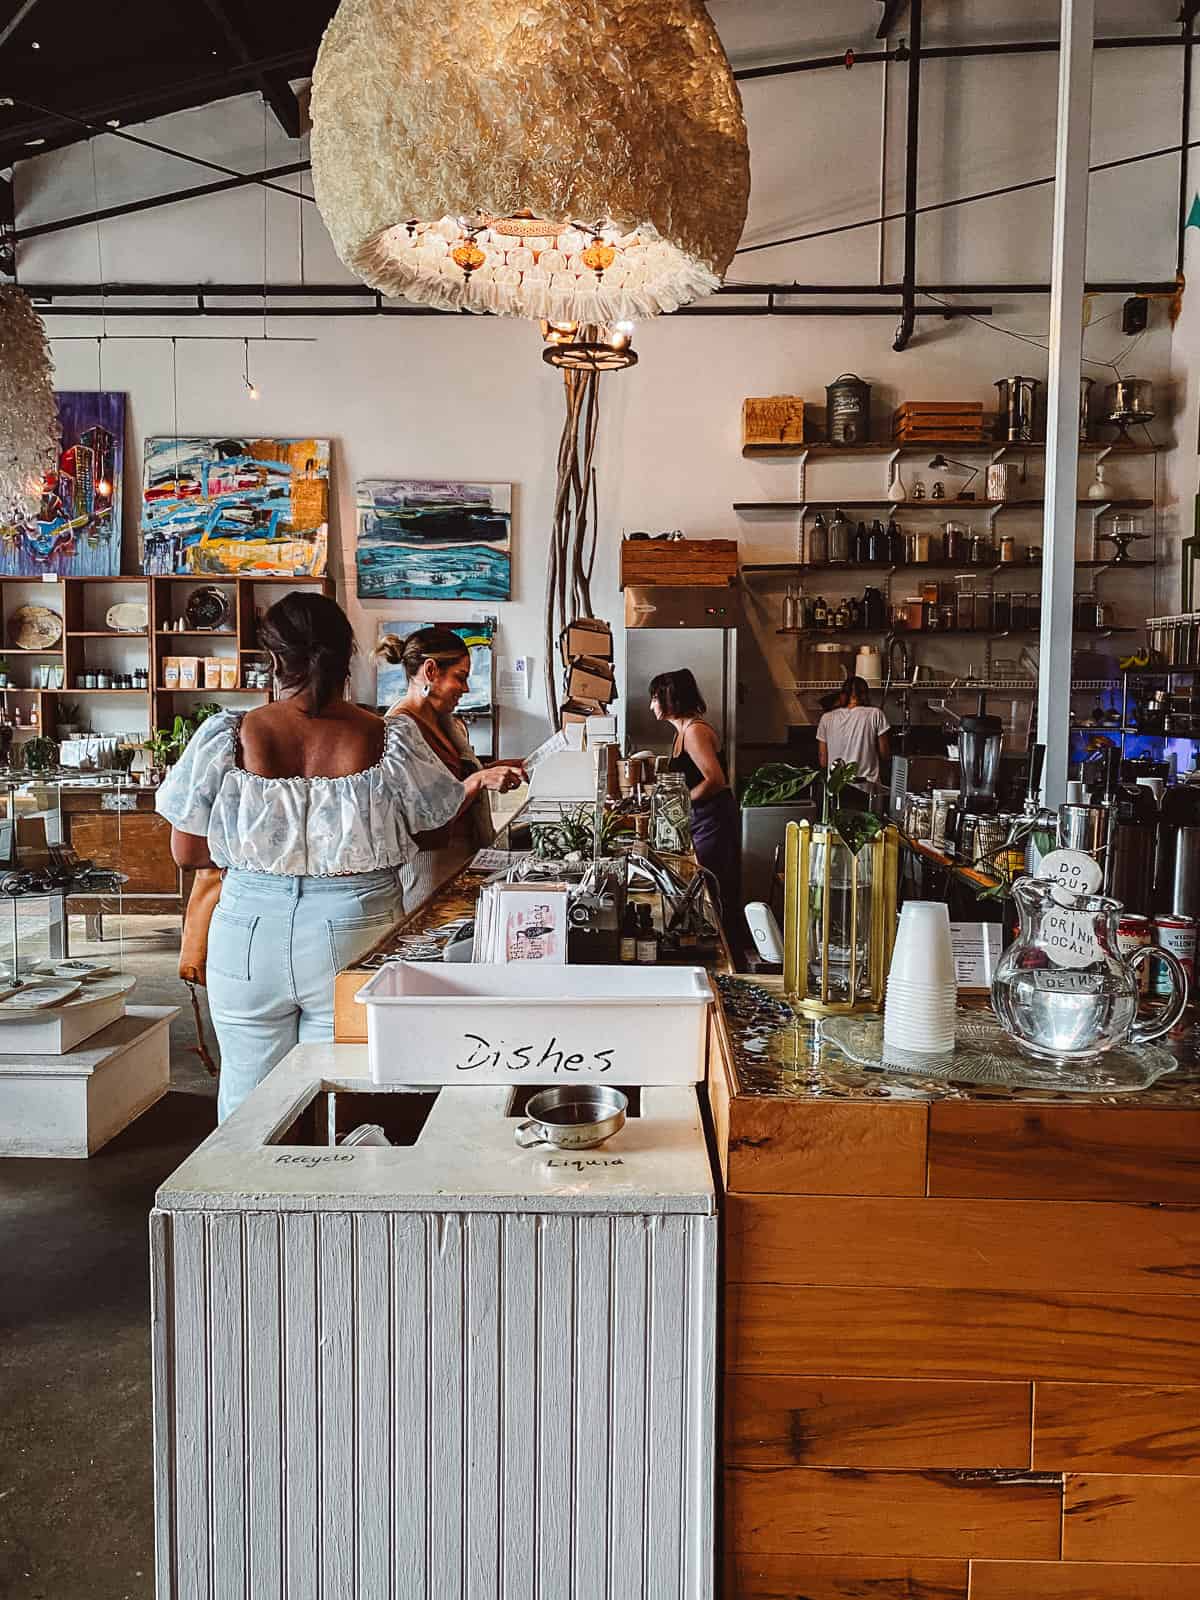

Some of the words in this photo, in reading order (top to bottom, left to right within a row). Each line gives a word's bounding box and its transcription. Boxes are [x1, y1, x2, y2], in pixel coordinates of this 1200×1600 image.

[1060, 863, 1081, 877] DO
[1050, 917, 1094, 946] DRINK
[456, 1033, 615, 1073] Dishes
